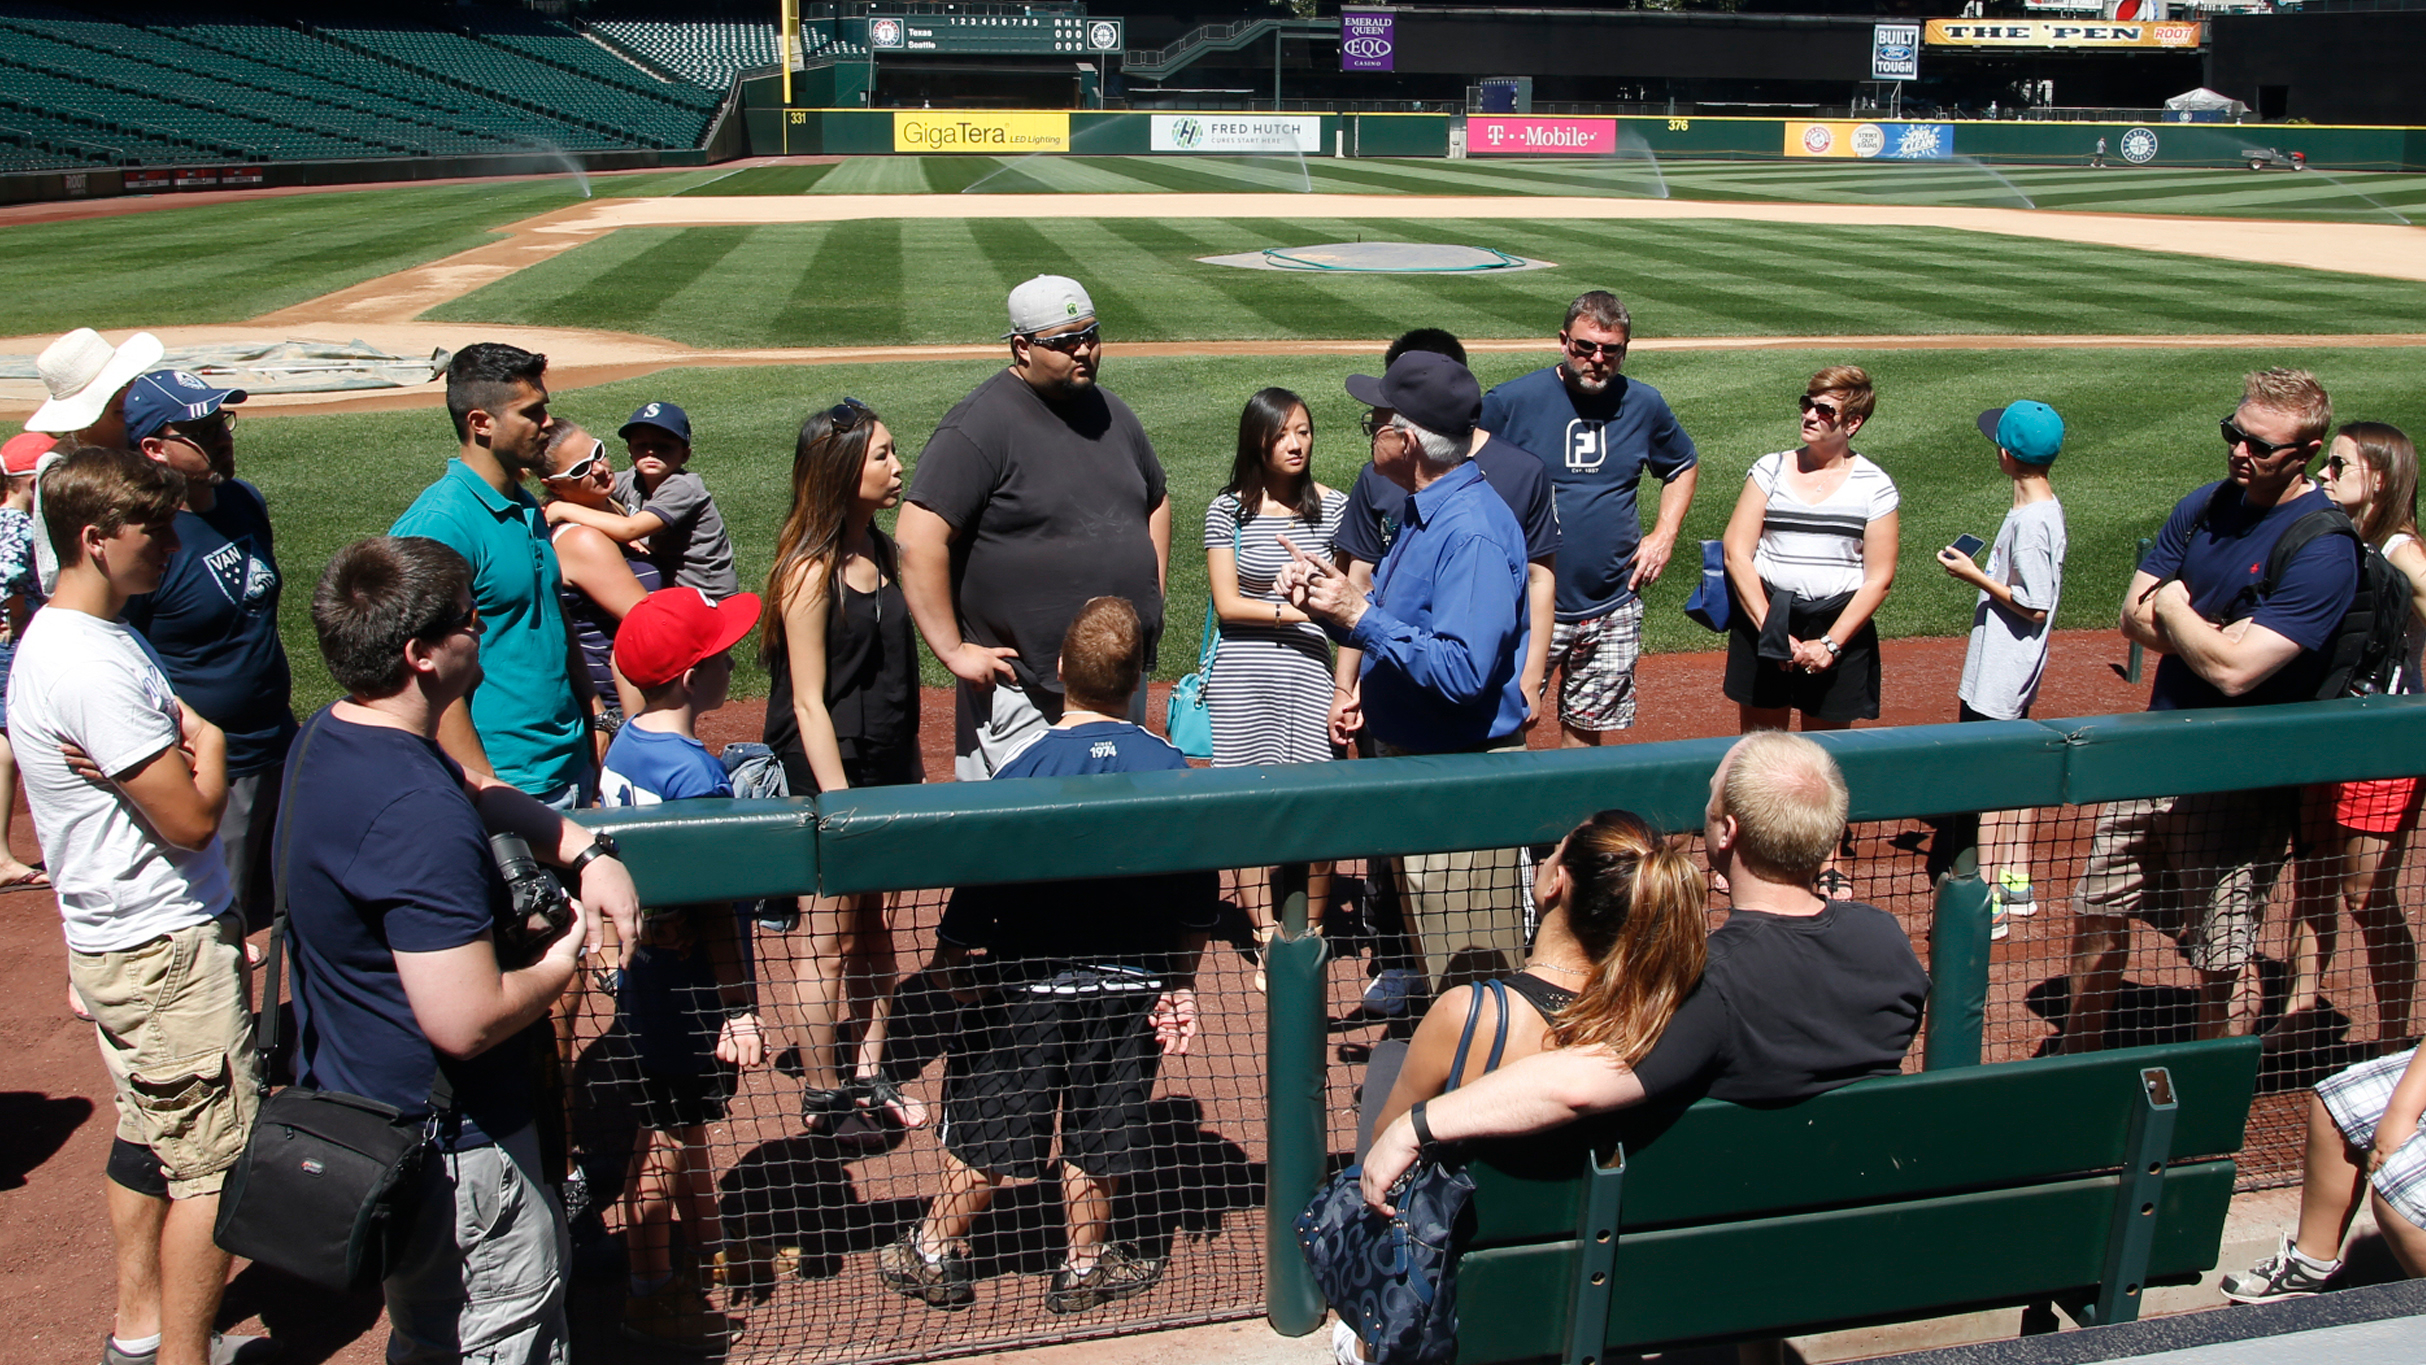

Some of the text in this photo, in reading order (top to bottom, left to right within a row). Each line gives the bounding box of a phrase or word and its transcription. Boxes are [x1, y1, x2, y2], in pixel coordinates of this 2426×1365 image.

[950, 17, 1082, 28] 1 2 3 4 5 6 7 8 9 R H E
[1344, 17, 1392, 27] EMERALD
[907, 27, 933, 37] Texas
[1055, 29, 1062, 39] 0
[1065, 29, 1073, 39] 0
[1075, 29, 1083, 39] 0
[1351, 26, 1384, 37] QUEEN
[1878, 30, 1914, 45] BUILT
[1944, 26, 2030, 39] THE
[2155, 27, 2192, 39] ROOT
[907, 40, 1083, 51] Seattle 0 0 0
[1877, 61, 1913, 73] TOUGH
[790, 112, 807, 125] 331
[1211, 123, 1301, 135] FRED HUTCH
[1668, 119, 1689, 132] 376
[1009, 135, 1024, 144] LED
[1027, 135, 1061, 147] Lighting
[1911, 130, 1931, 141] OXI
[1903, 138, 1935, 152] CLEAN
[642, 402, 661, 419] S
[209, 546, 243, 571] VAN
[1089, 745, 1118, 759] 1974
